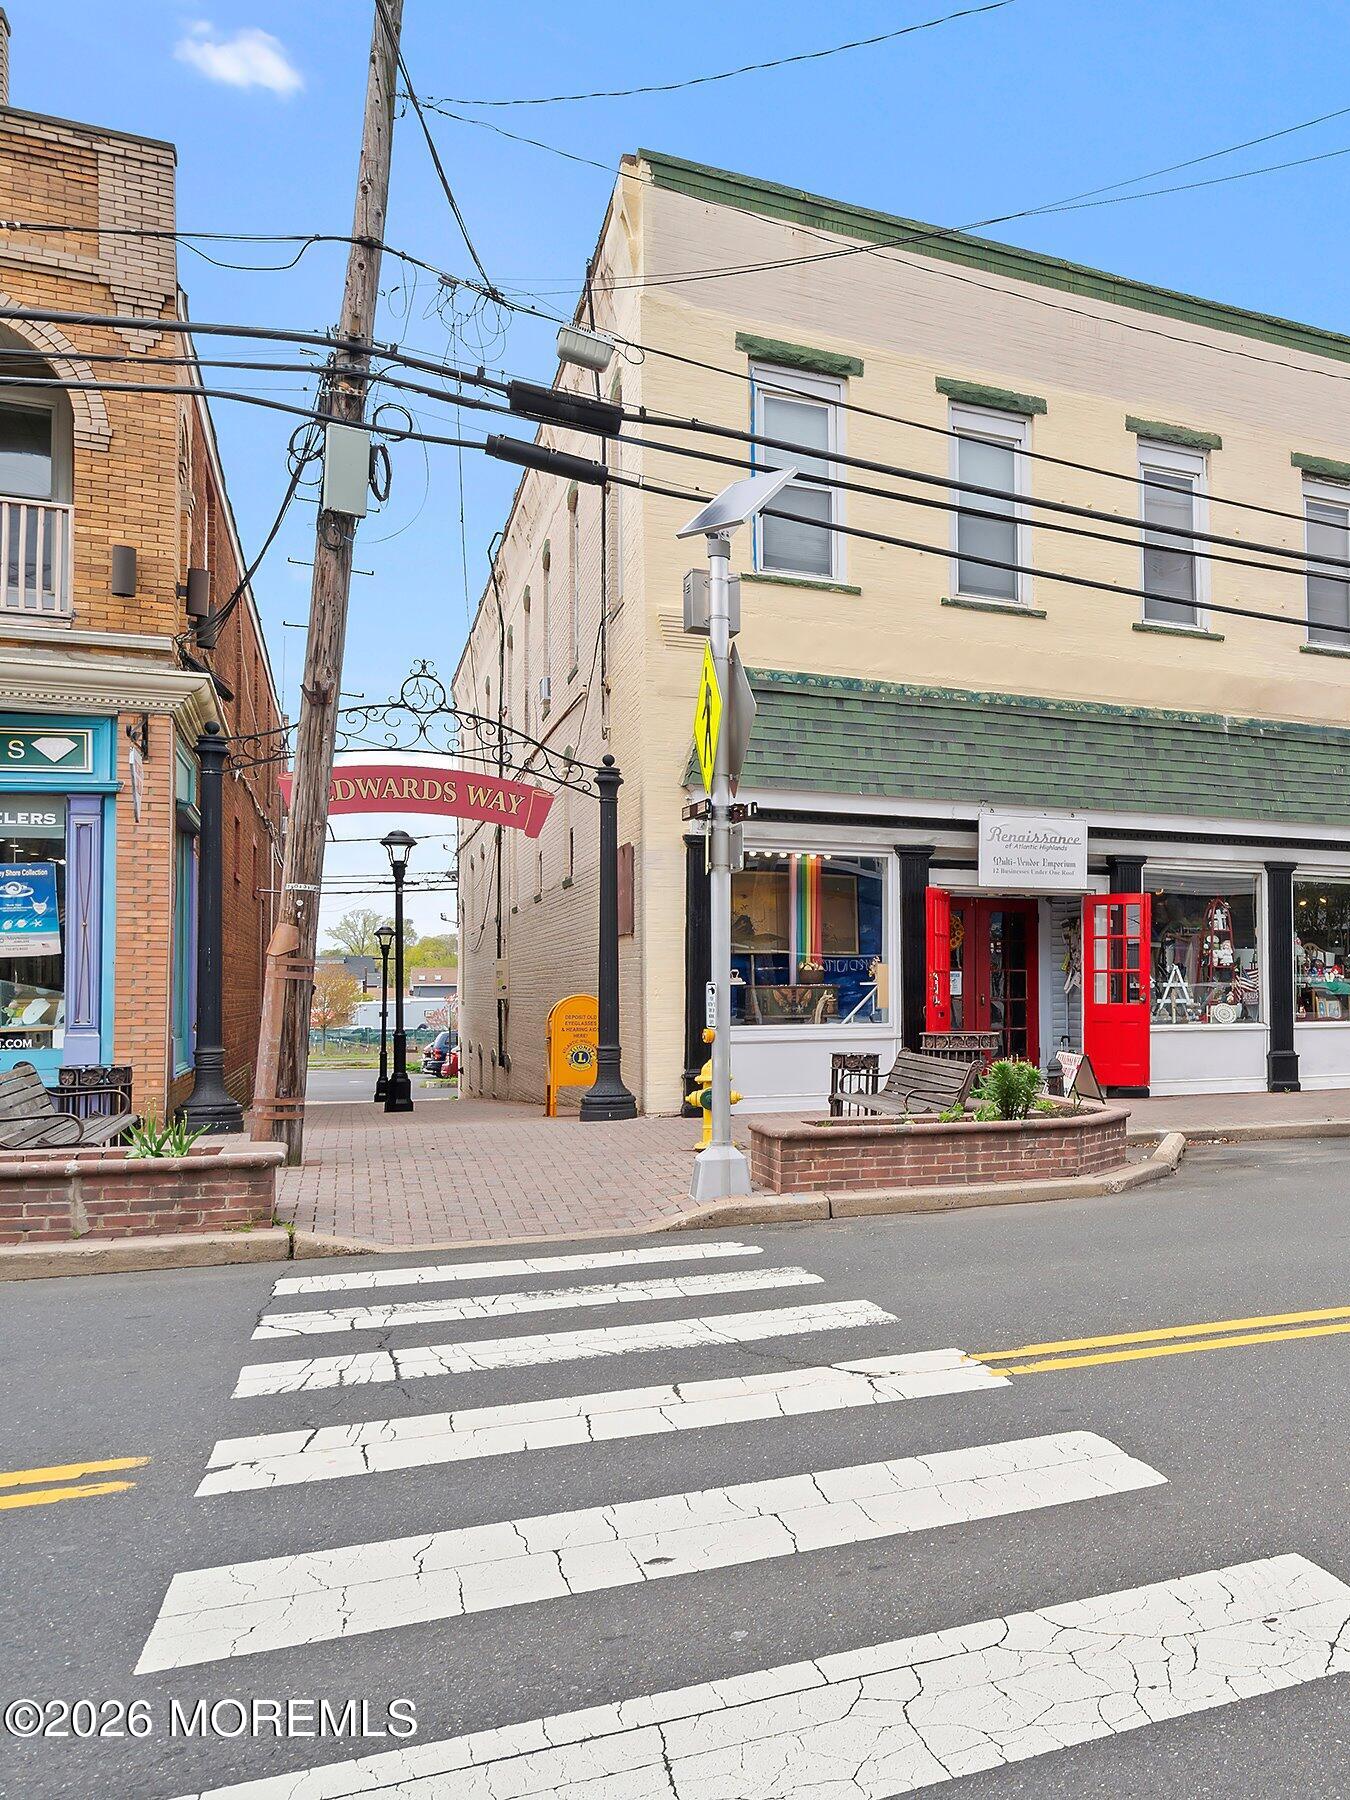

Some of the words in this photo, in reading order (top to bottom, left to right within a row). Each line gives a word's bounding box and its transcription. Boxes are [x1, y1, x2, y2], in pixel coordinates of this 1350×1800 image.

[7, 739, 26, 759] S
[466, 784, 526, 816] WAY
[0, 811, 57, 825] LERS
[986, 826, 1082, 846] Renaissance
[1013, 843, 1038, 851] Atlantic
[1042, 858, 1077, 870] Emporium
[577, 1052, 586, 1063] L
